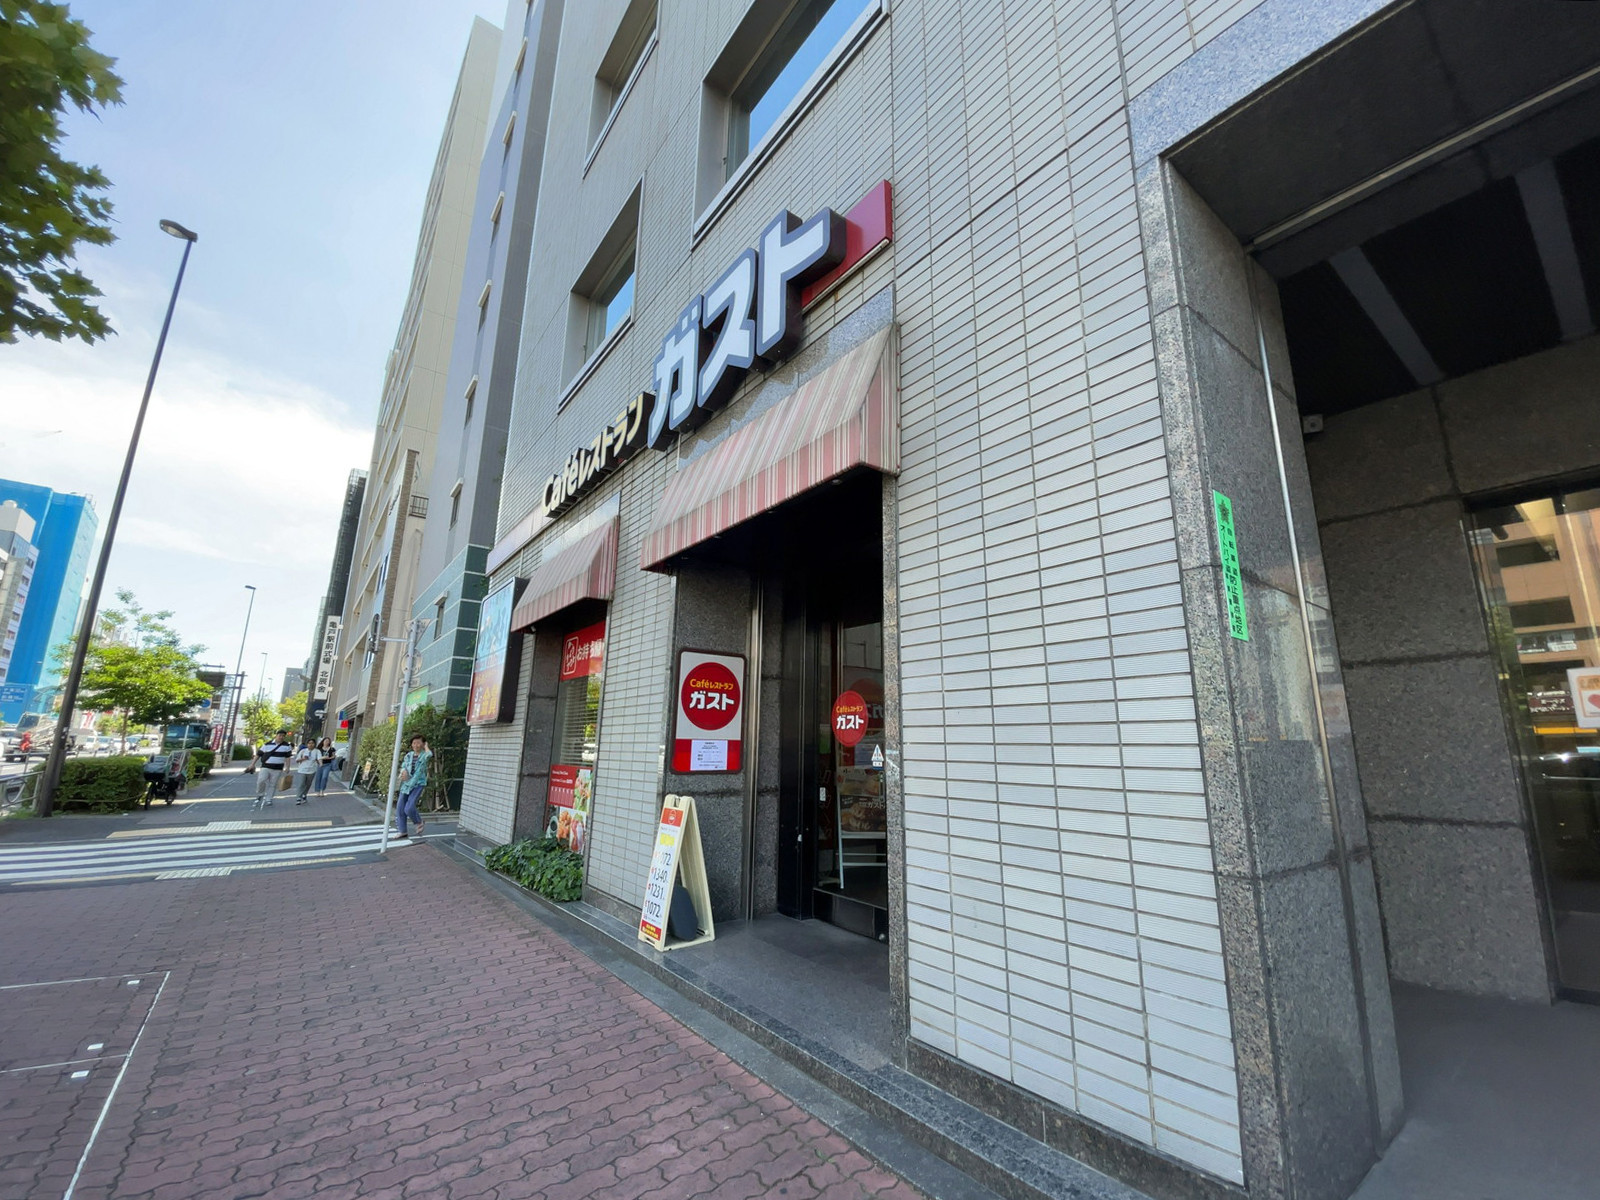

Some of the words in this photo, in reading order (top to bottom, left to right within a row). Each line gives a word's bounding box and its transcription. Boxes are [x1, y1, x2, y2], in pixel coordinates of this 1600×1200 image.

[647, 207, 831, 448] ガスト
[690, 678, 734, 691] Caféレストラン
[689, 691, 735, 711] ガスト
[836, 715, 865, 730] ガスト
